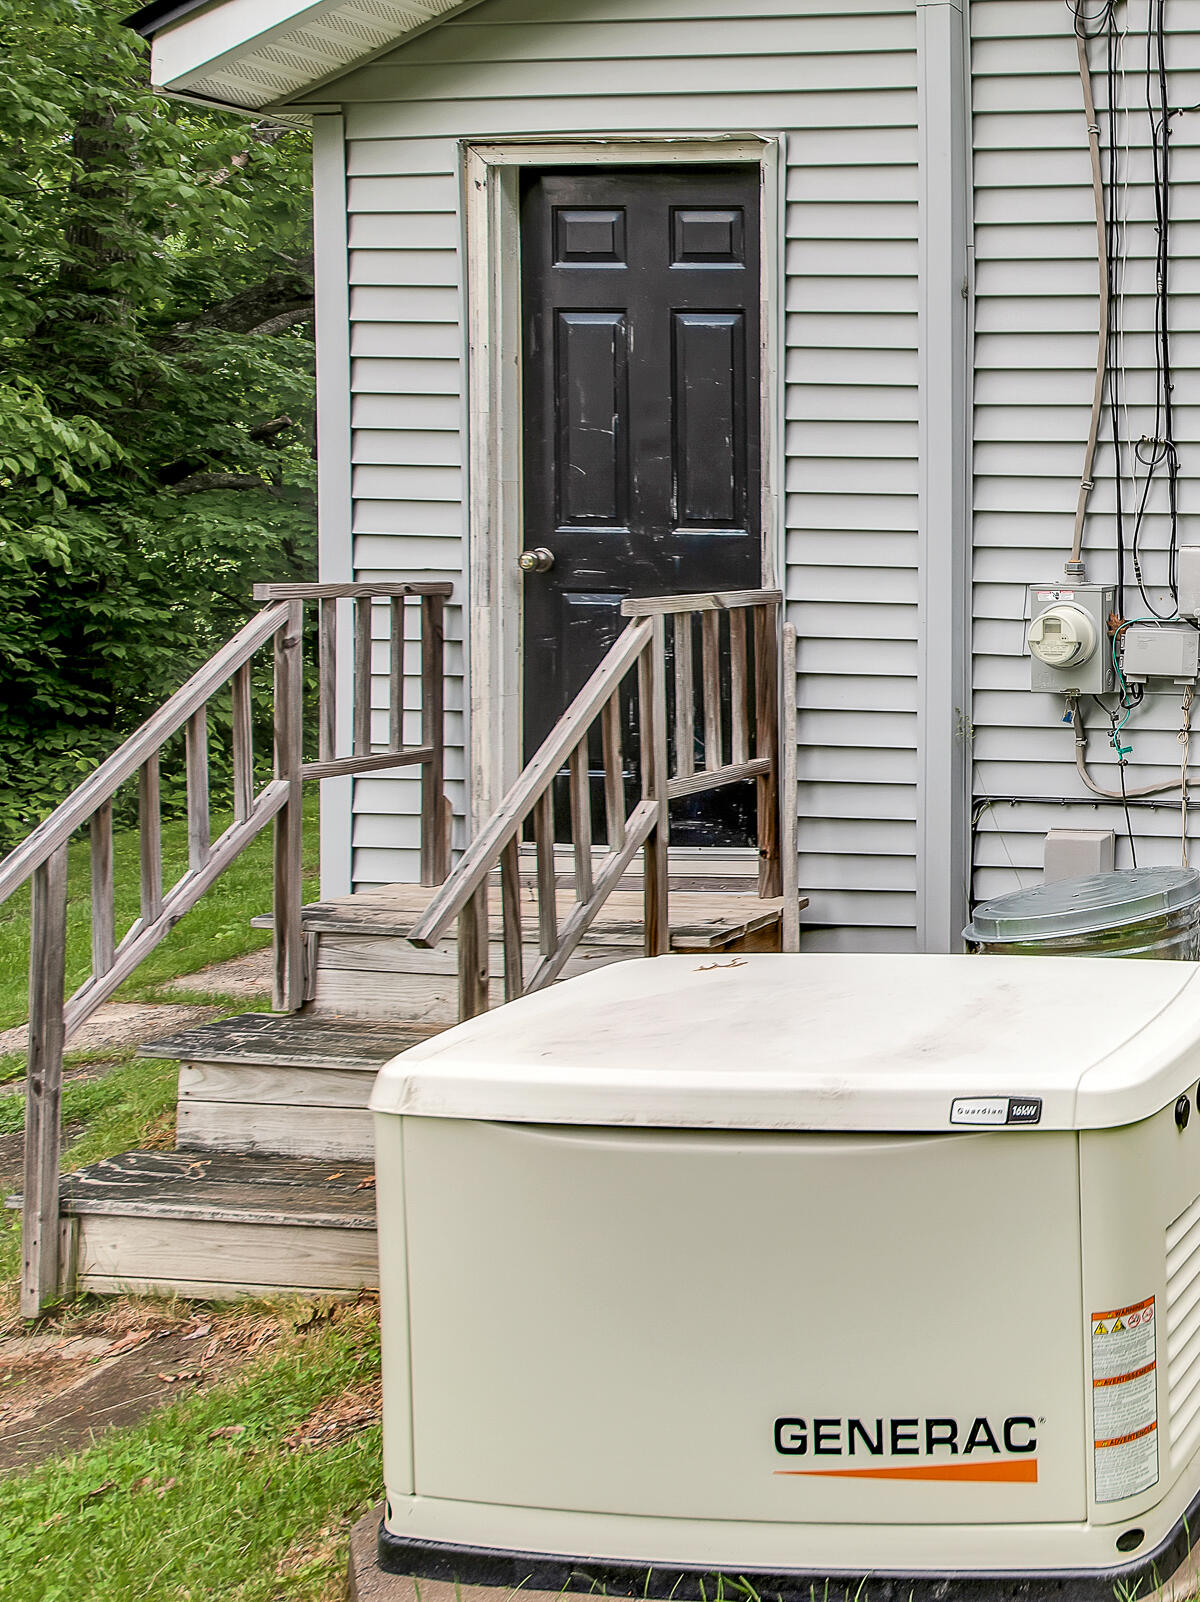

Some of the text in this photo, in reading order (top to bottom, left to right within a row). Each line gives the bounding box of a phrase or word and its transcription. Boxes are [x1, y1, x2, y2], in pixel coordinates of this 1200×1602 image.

[957, 1107, 1003, 1115] Guardian
[1115, 1302, 1145, 1318] WARNING
[773, 1416, 1038, 1456] GENERAC
